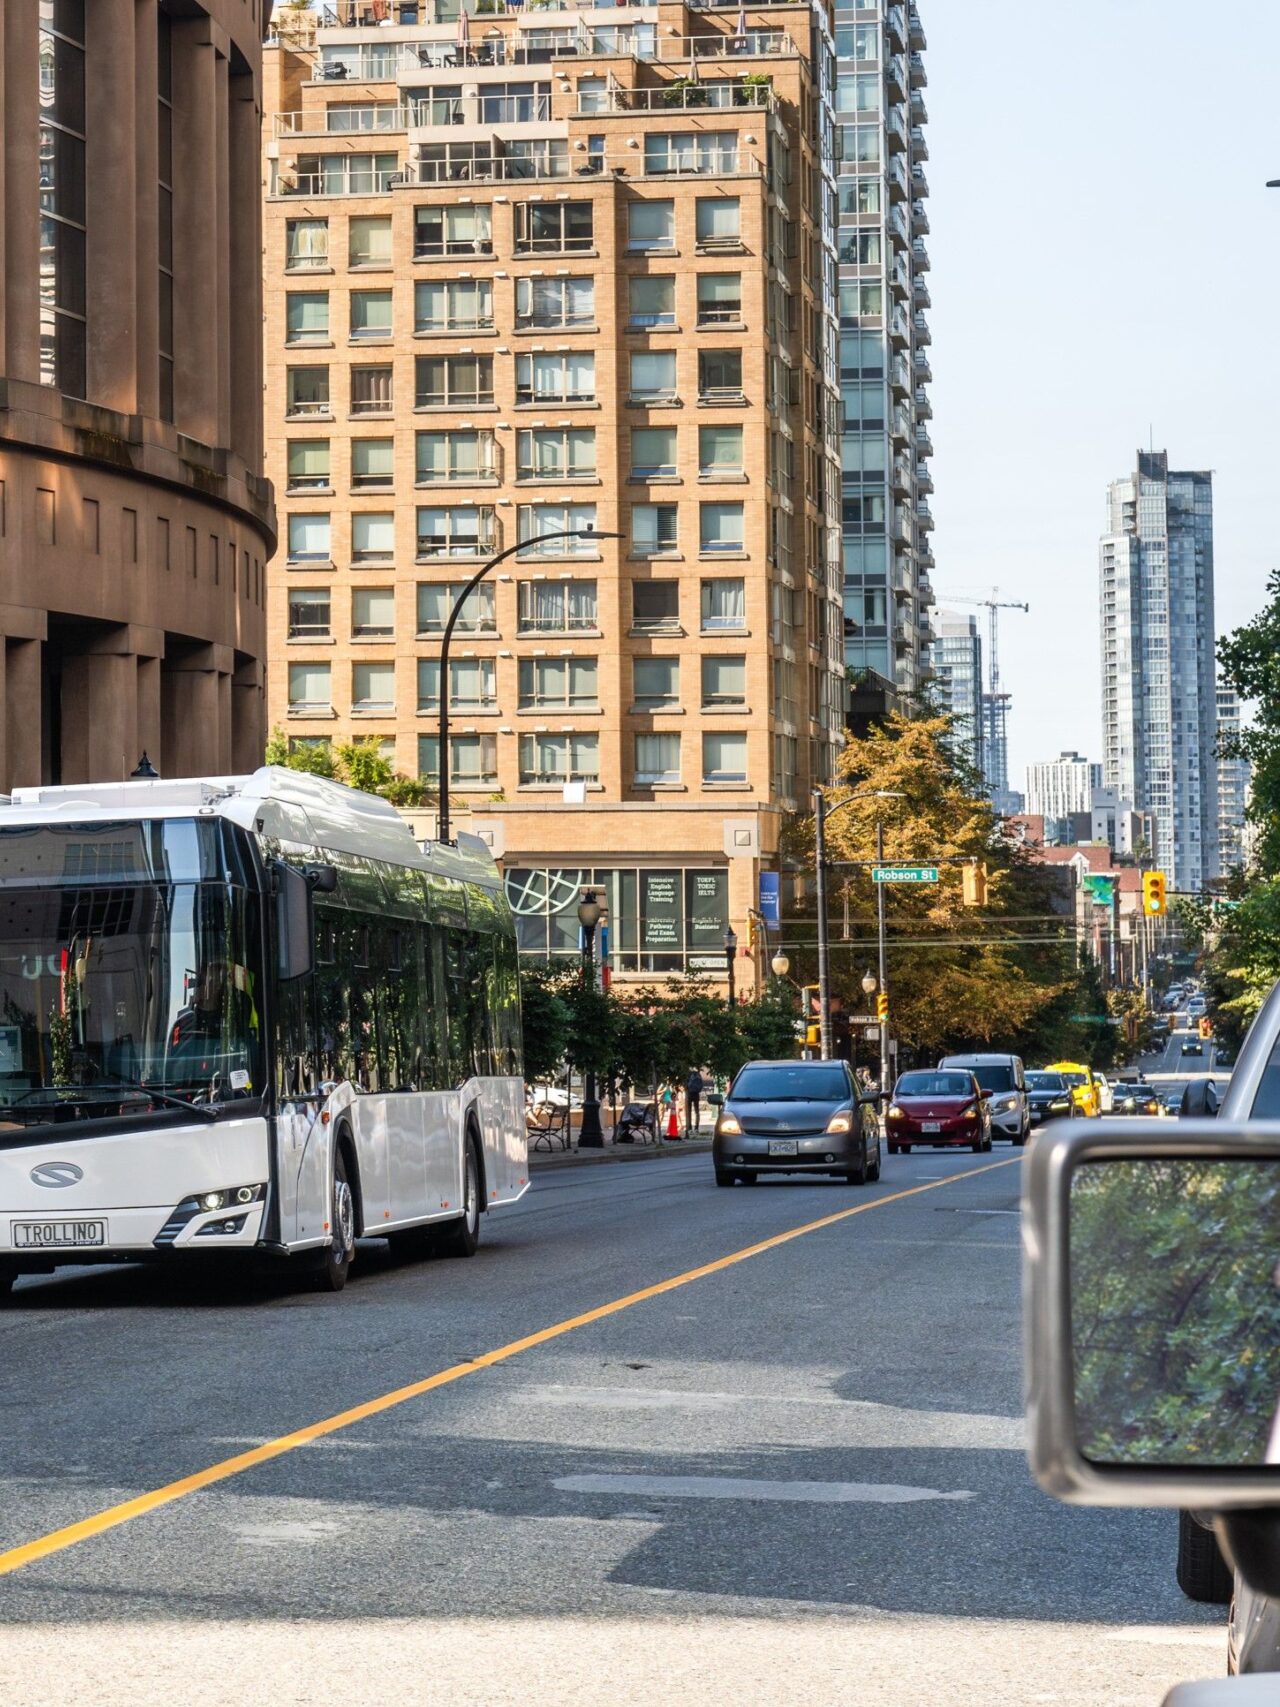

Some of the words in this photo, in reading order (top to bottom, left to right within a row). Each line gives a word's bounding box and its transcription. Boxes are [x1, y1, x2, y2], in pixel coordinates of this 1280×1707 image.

[877, 870, 917, 880] Robson
[921, 870, 933, 880] St
[22, 1224, 96, 1242] TROLLINO
